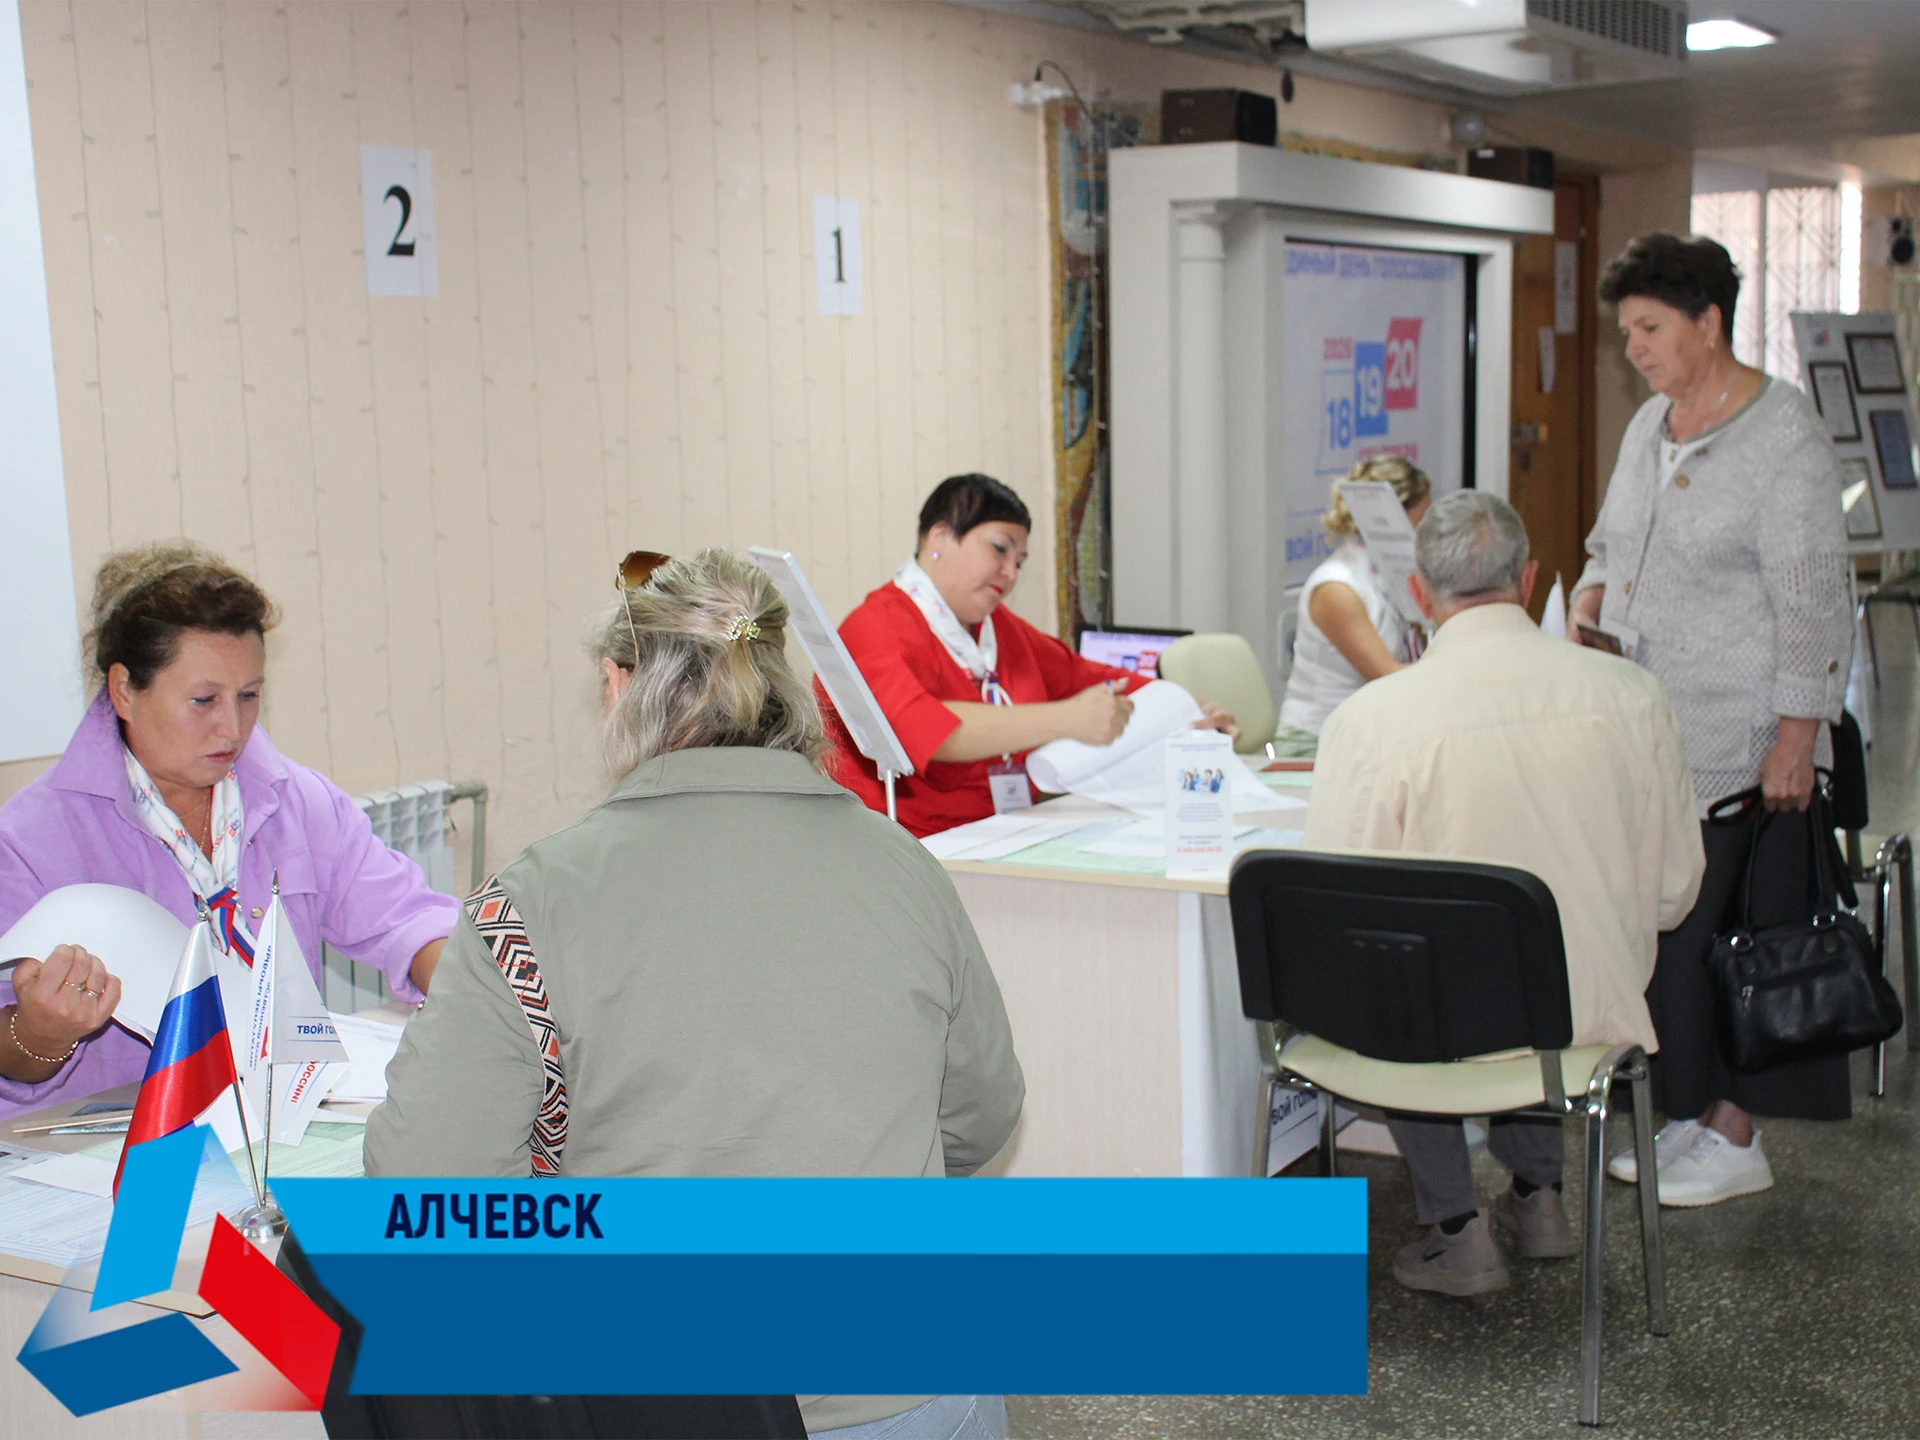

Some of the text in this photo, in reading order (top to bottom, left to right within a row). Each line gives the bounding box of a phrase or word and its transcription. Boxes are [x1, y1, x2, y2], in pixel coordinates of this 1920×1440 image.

[383, 184, 416, 256] 2
[831, 226, 848, 283] 1
[1386, 339, 1416, 390] 20
[1358, 365, 1382, 418] 19
[1327, 398, 1351, 449] 18
[297, 1023, 323, 1034] ТВОЙ
